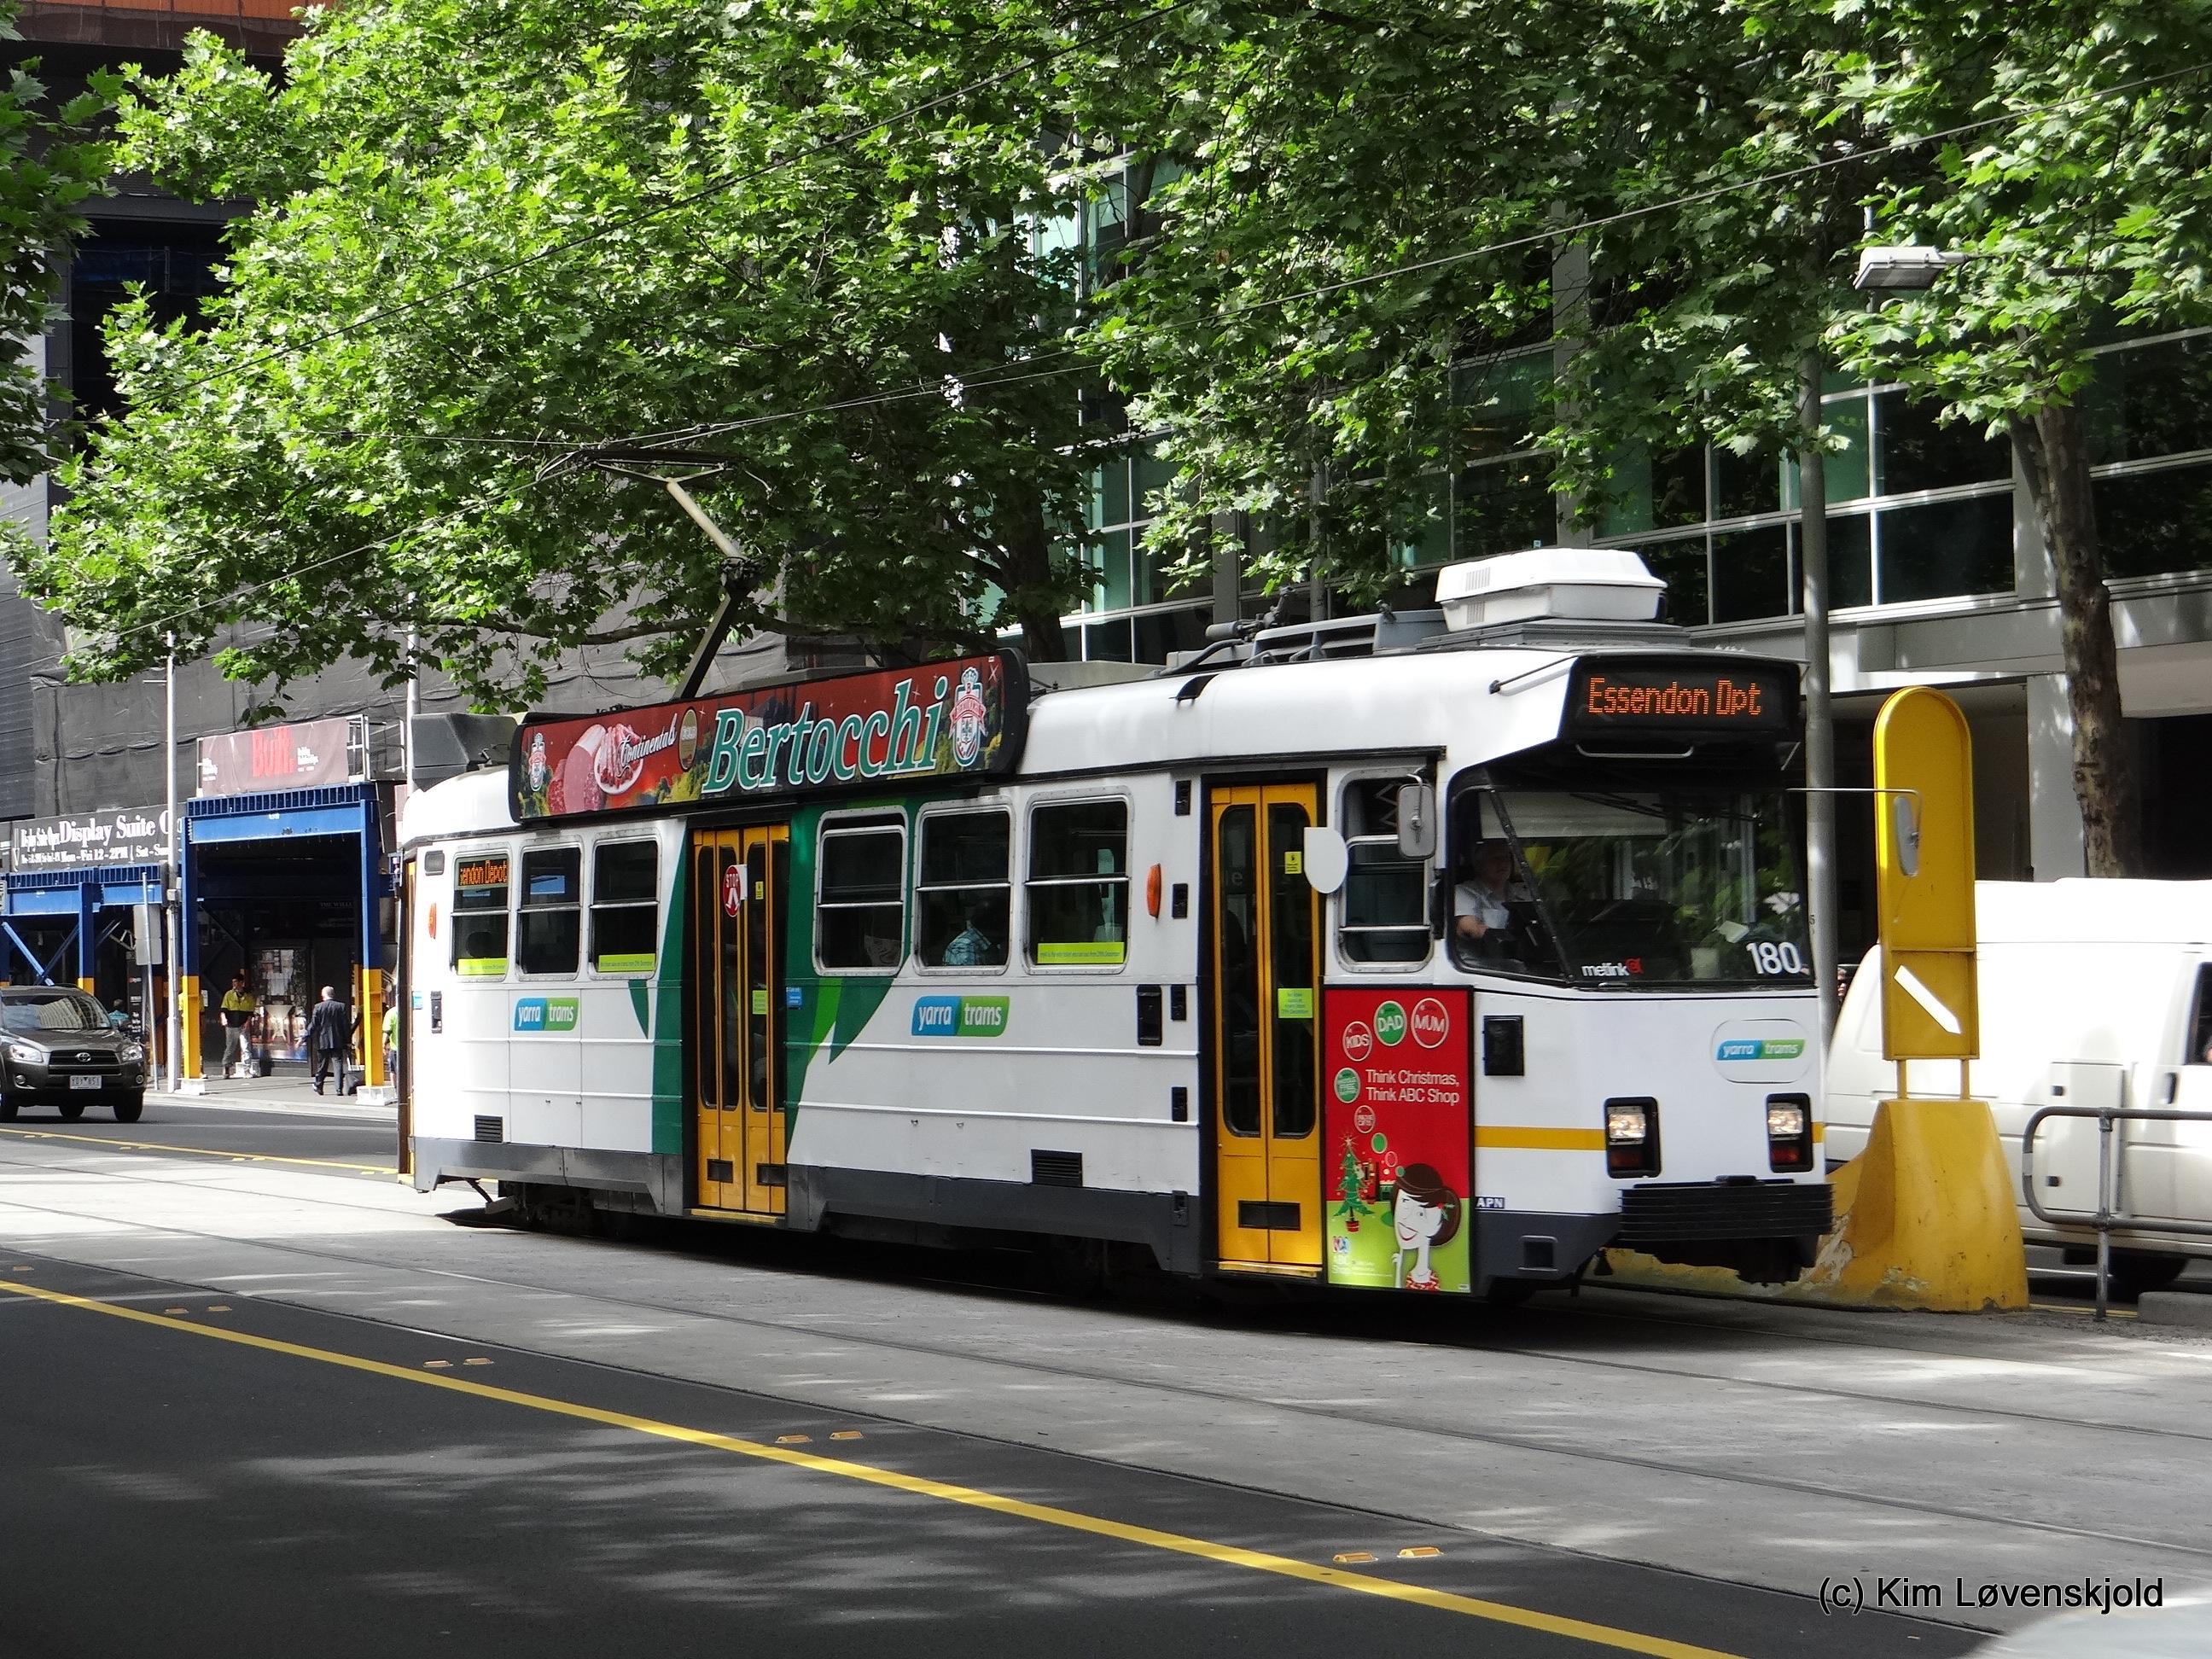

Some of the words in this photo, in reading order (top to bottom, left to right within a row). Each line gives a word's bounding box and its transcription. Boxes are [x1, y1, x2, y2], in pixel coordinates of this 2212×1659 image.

[1588, 678, 1708, 714] Essendon
[1715, 679, 1764, 715] Dpt
[617, 713, 678, 768] Continentals
[701, 676, 948, 794] Bertocchi
[59, 818, 113, 848] Display
[116, 815, 156, 839] Suite
[485, 859, 507, 884] Depot
[1745, 941, 1802, 975] 180
[518, 1004, 541, 1027] yarra
[548, 1003, 574, 1022] trams
[918, 1004, 952, 1031] yarra
[963, 1003, 1002, 1026] trams
[1377, 1015, 1404, 1033] DAD
[1414, 1014, 1445, 1033] MUM
[1346, 1033, 1370, 1049] KIDS
[1722, 1045, 1755, 1058] yarra
[1765, 1043, 1798, 1055] trams
[1365, 1068, 1397, 1084] Think
[1398, 1068, 1459, 1087] Christmas,
[1365, 1086, 1398, 1102] Think
[1398, 1087, 1426, 1103] ABC
[1427, 1088, 1460, 1107] Shop
[1476, 1197, 1504, 1208] APN
